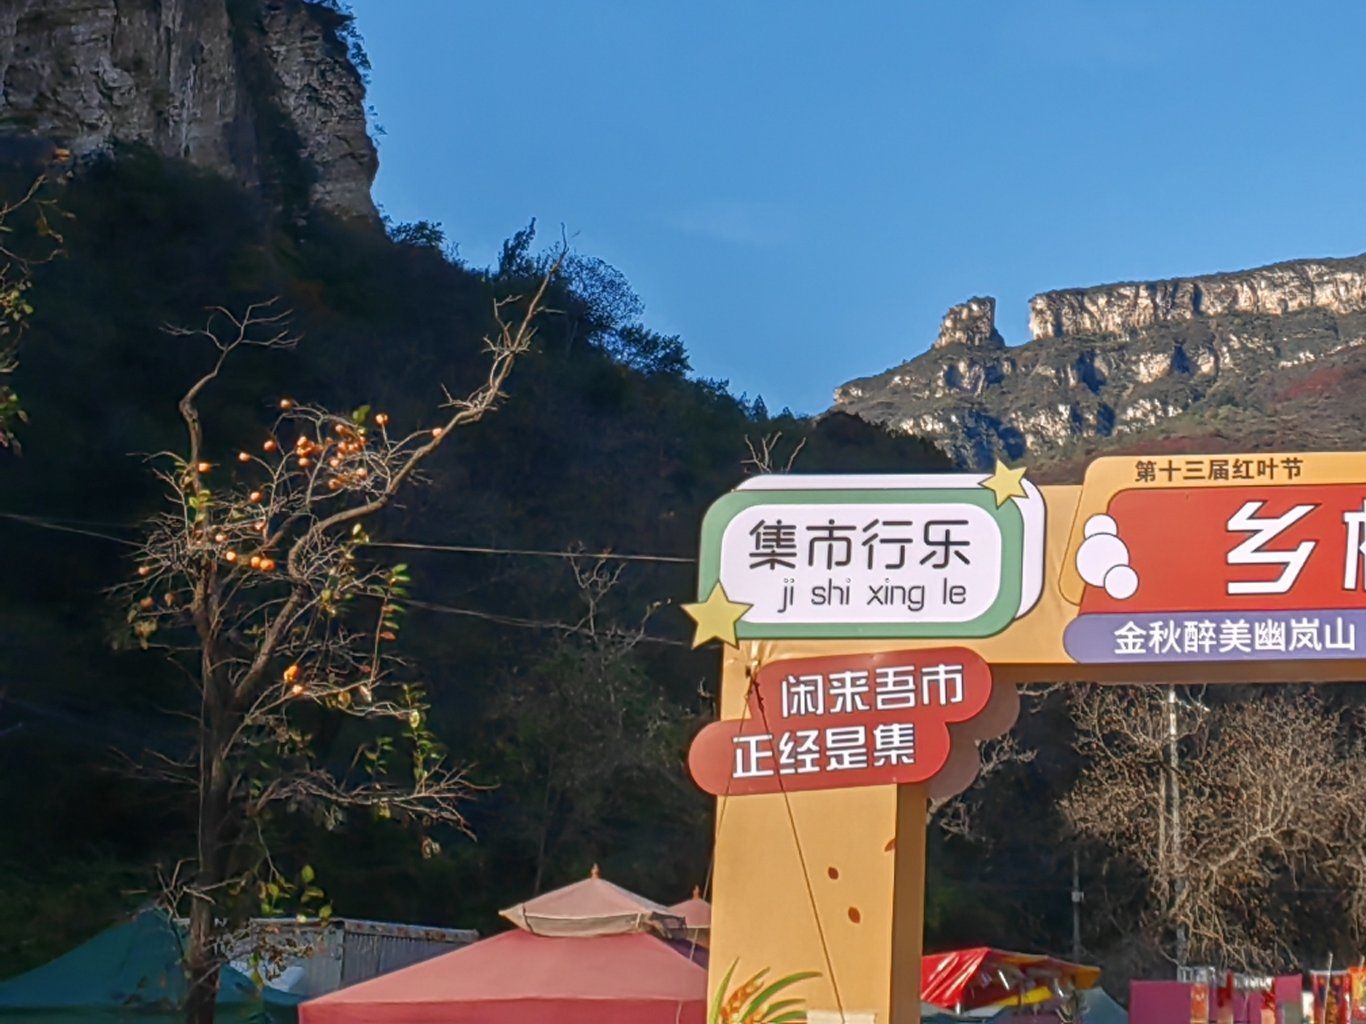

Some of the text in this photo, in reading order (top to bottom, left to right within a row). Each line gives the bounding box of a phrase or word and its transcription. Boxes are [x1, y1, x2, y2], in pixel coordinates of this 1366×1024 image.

[1135, 457, 1304, 483] 第十三届红叶节
[748, 518, 971, 570] 集市行乐
[777, 577, 967, 613] ji shi xing le
[1113, 617, 1357, 655] 金秋醉美幽岚山
[781, 663, 964, 719] 闲来吾市
[732, 723, 915, 779] 正经是集
